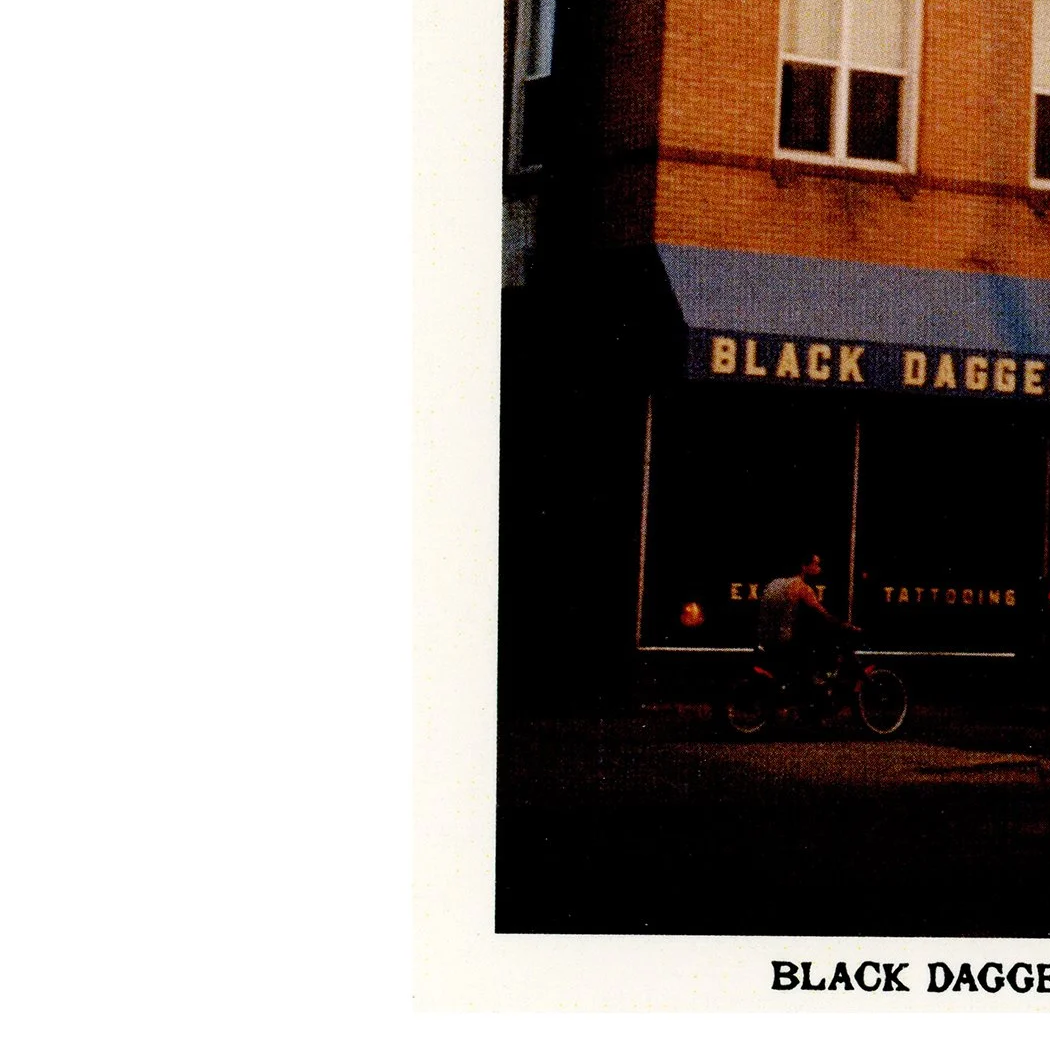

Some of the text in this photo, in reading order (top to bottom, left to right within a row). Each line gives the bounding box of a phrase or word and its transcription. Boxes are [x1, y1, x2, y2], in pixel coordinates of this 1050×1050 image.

[711, 336, 864, 382] BLACK
[730, 582, 1017, 607] EXT TATTOOING
